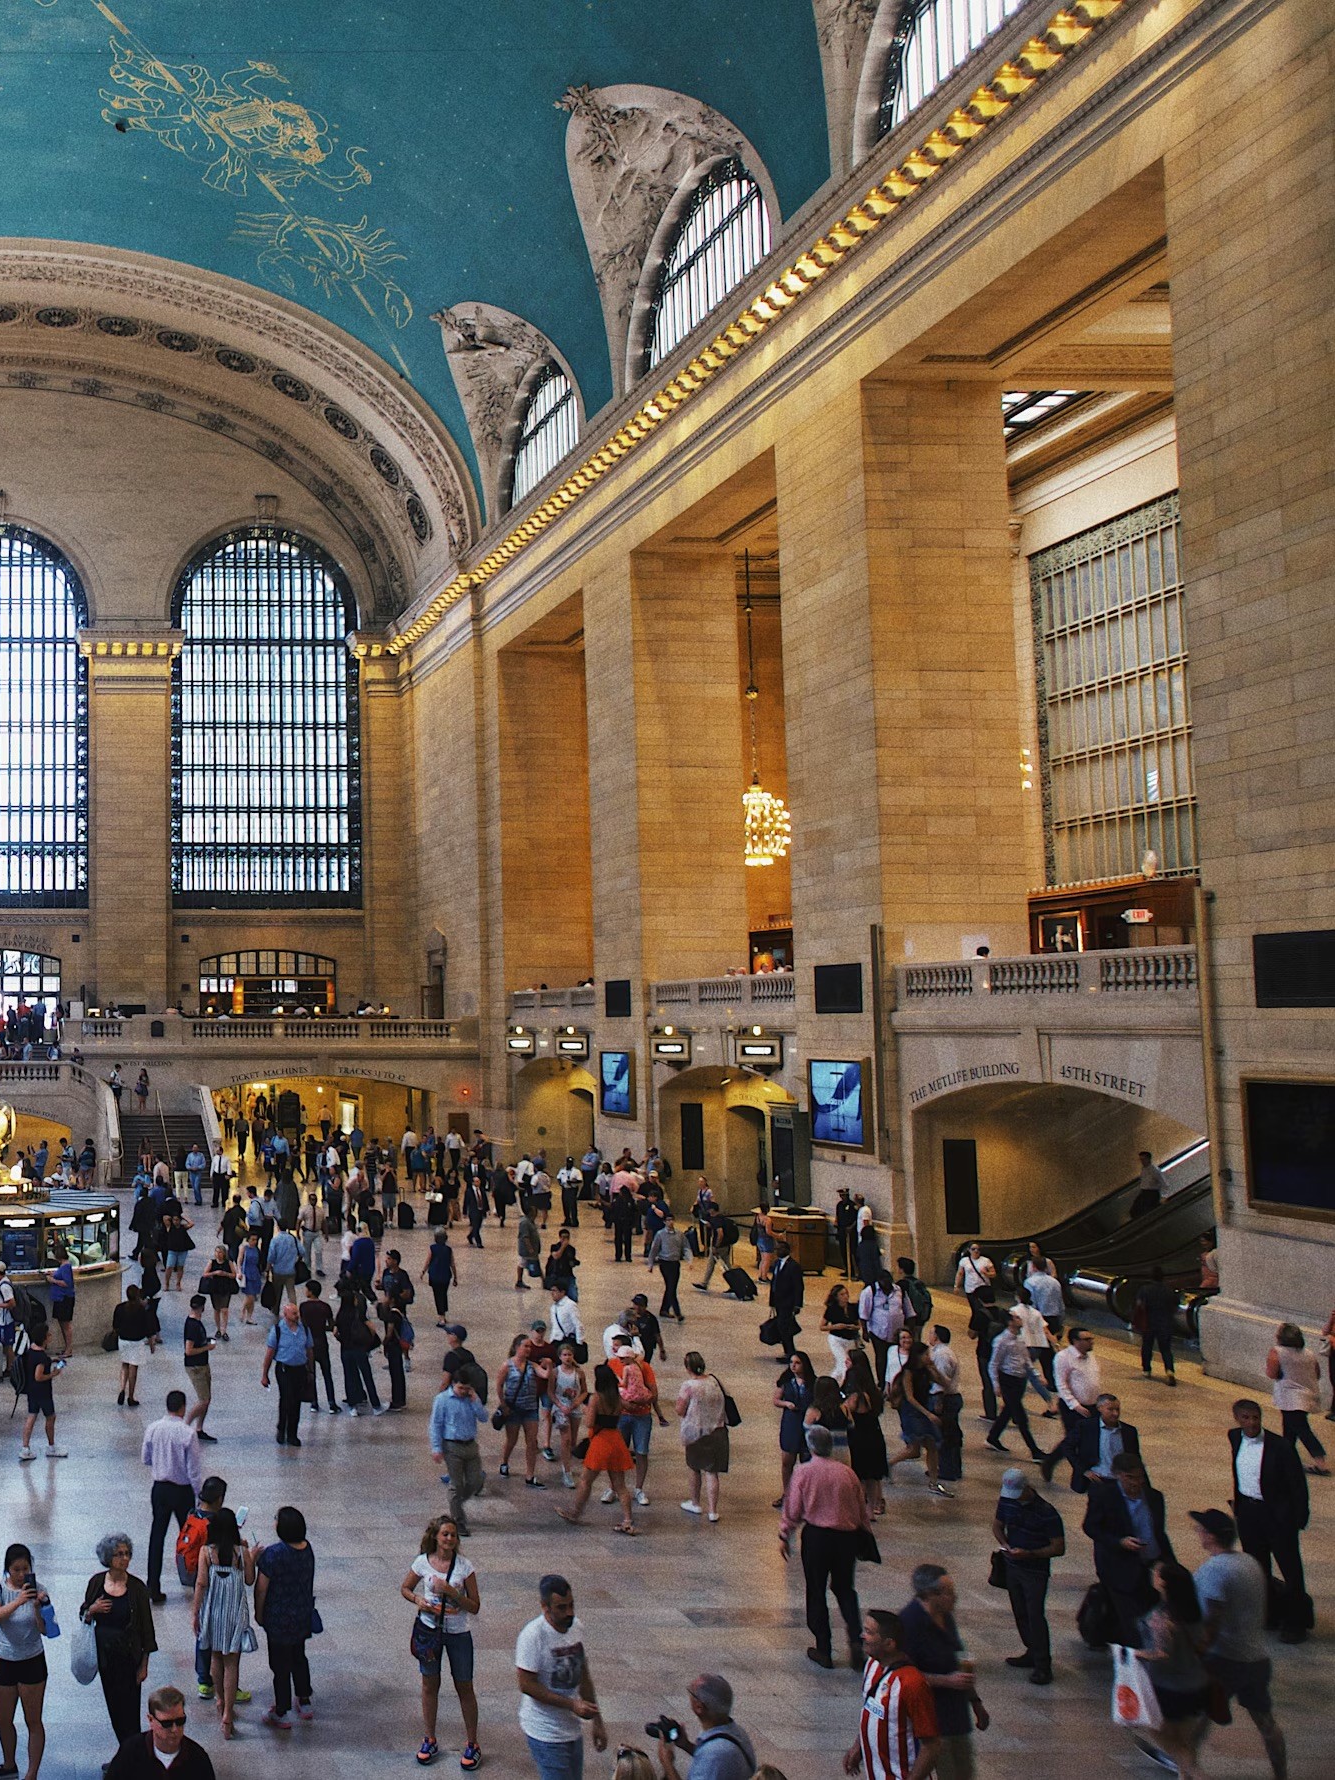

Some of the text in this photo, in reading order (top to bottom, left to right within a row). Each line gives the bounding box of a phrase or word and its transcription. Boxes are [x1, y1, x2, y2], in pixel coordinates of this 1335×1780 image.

[14, 933, 49, 944] AVENUE
[231, 1067, 309, 1082] TICKET MACHINES
[338, 1066, 372, 1076] TRACKS
[382, 1071, 396, 1079] TO
[909, 1062, 1020, 1103] THE METLIFE BUILDING
[1060, 1065, 1147, 1098] 45TH STREET
